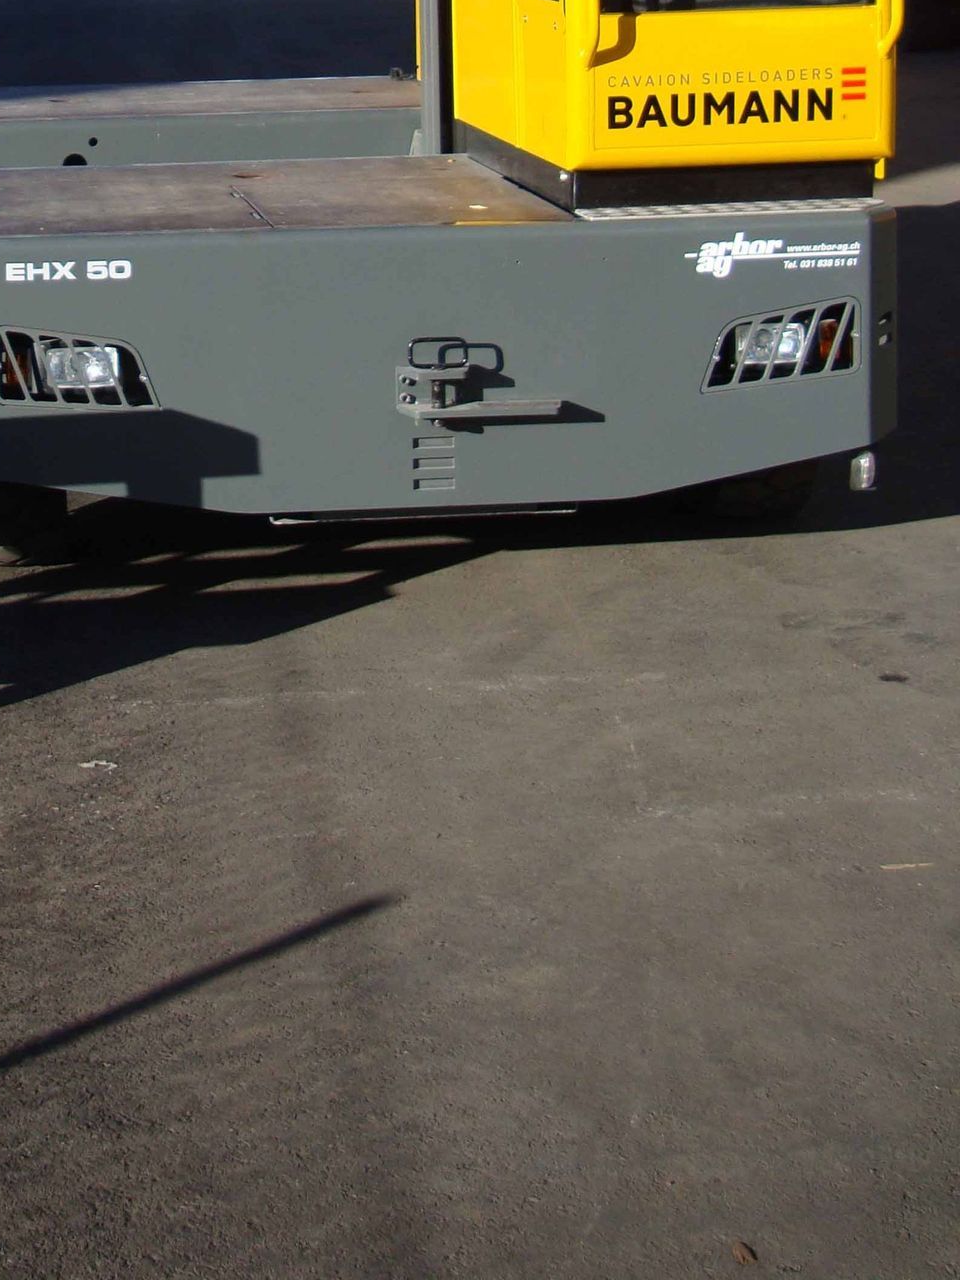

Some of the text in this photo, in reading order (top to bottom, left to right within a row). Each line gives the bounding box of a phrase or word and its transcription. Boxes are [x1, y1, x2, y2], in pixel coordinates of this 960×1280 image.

[607, 67, 834, 88] CAVAION SIDELOADERS
[607, 87, 834, 130] BAUMANN
[699, 232, 783, 256] arbor
[786, 241, 861, 252] www.arbor-ag.ch
[5, 260, 133, 282] EHX 50
[696, 256, 733, 278] ag
[783, 259, 798, 269] Tel.
[799, 259, 816, 268] 031
[834, 258, 845, 267] 51
